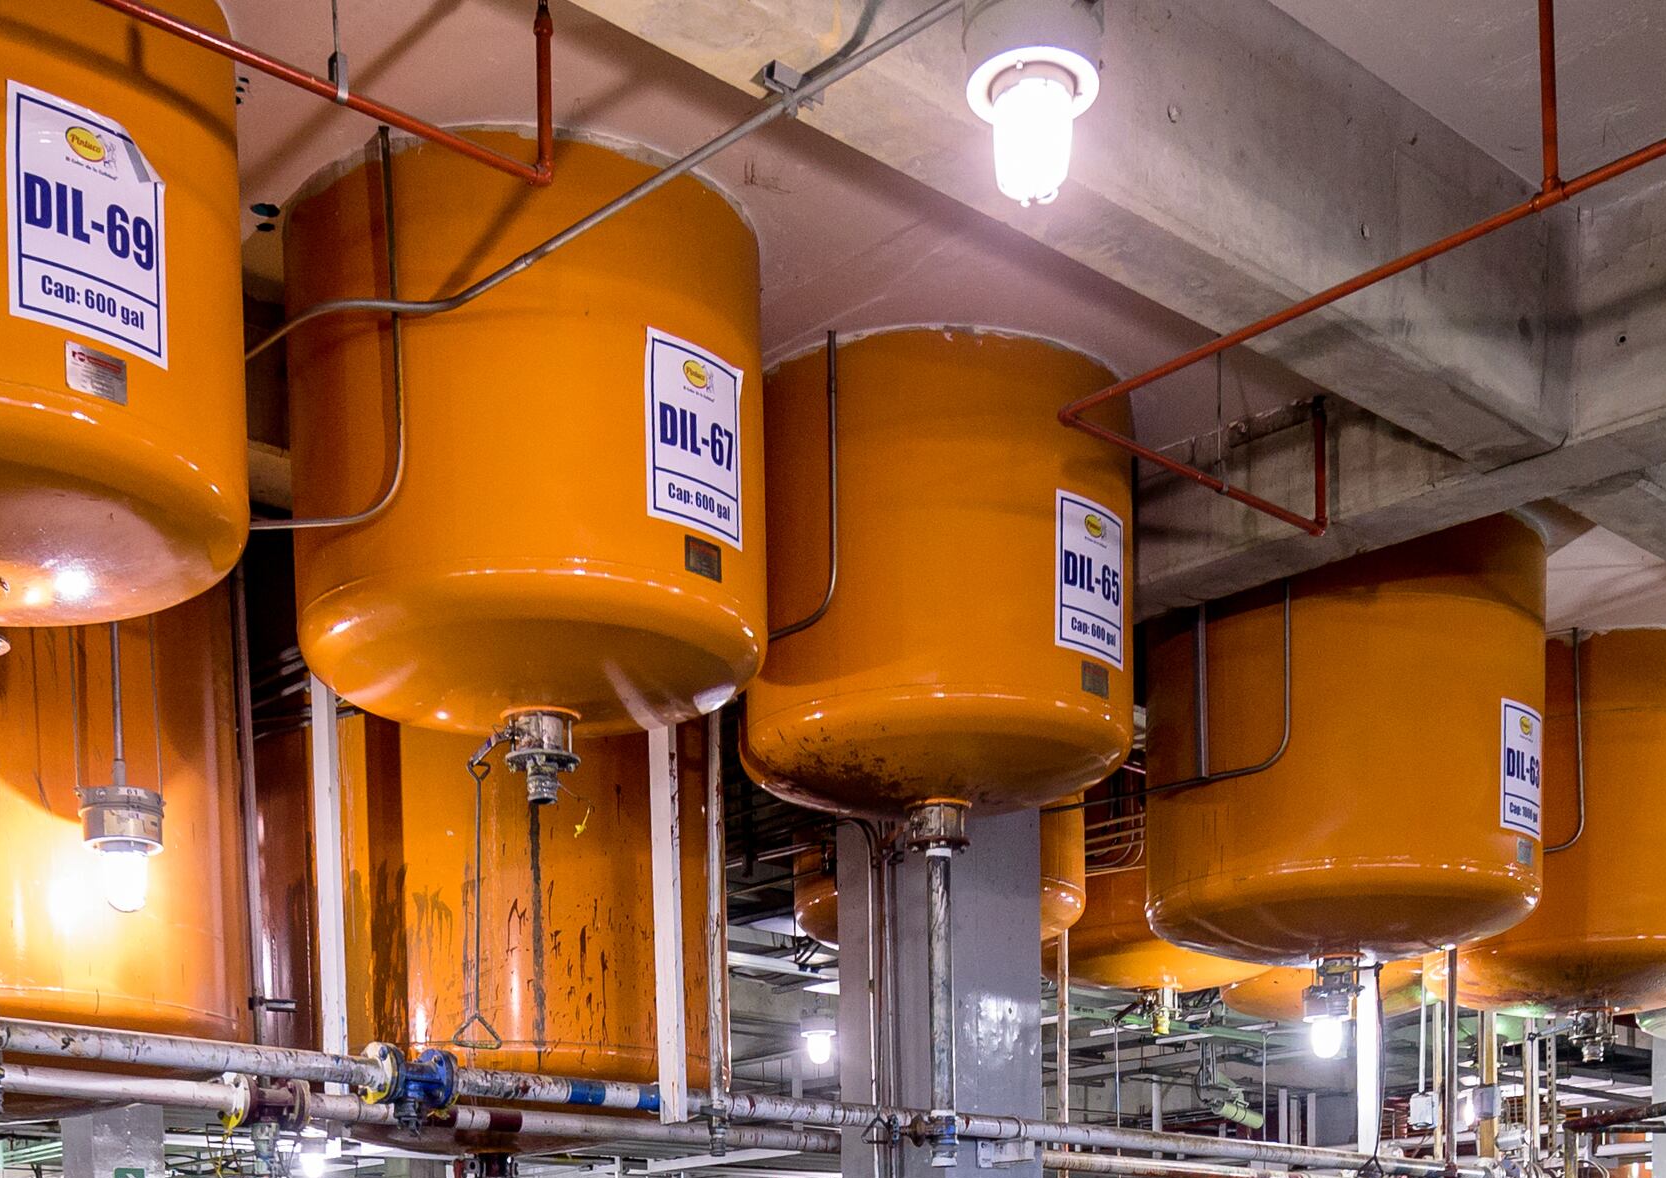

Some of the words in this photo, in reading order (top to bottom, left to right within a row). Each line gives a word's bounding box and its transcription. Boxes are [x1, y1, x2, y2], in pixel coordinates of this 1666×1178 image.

[24, 171, 154, 271] DIL-69
[41, 274, 80, 305] Cap:
[84, 288, 117, 318] 600
[120, 305, 145, 331] gal
[659, 401, 734, 472] DIL-67
[668, 482, 693, 505] Cap:
[695, 491, 715, 514] 600
[716, 503, 731, 522] gal
[1064, 549, 1120, 607] DIL-65
[1071, 616, 1090, 635] Cap:
[1091, 623, 1106, 641] 600
[1506, 747, 1540, 789] DIL-63
